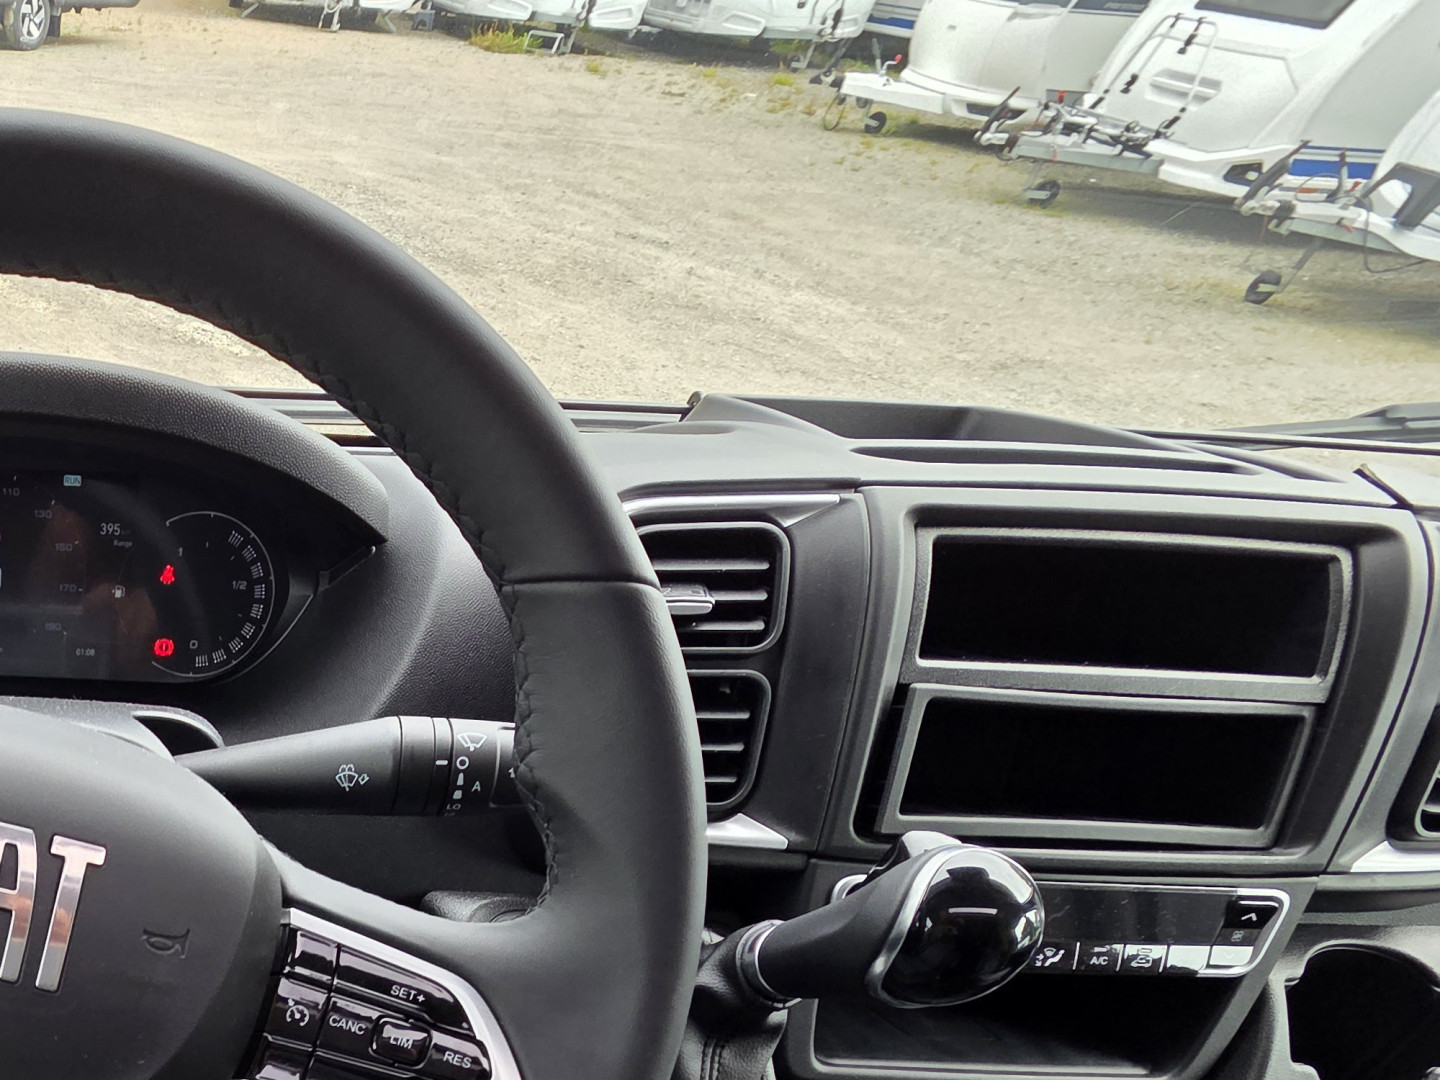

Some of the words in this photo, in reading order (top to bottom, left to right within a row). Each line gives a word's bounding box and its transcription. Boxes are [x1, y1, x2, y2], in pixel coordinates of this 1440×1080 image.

[2, 487, 20, 496] 110
[34, 509, 53, 519] 130
[100, 523, 121, 536] 395
[55, 543, 73, 552] 150
[113, 539, 133, 548] Range
[59, 583, 77, 593] 170
[232, 580, 247, 590] 1/2
[189, 640, 198, 649] 0
[472, 781, 482, 793] A
[446, 802, 461, 811] LO
[1089, 954, 1109, 967] A/C
[390, 984, 426, 1004] SET+
[329, 1015, 367, 1036] CANC
[390, 1034, 413, 1050] LIM
[444, 1050, 472, 1069] RES
